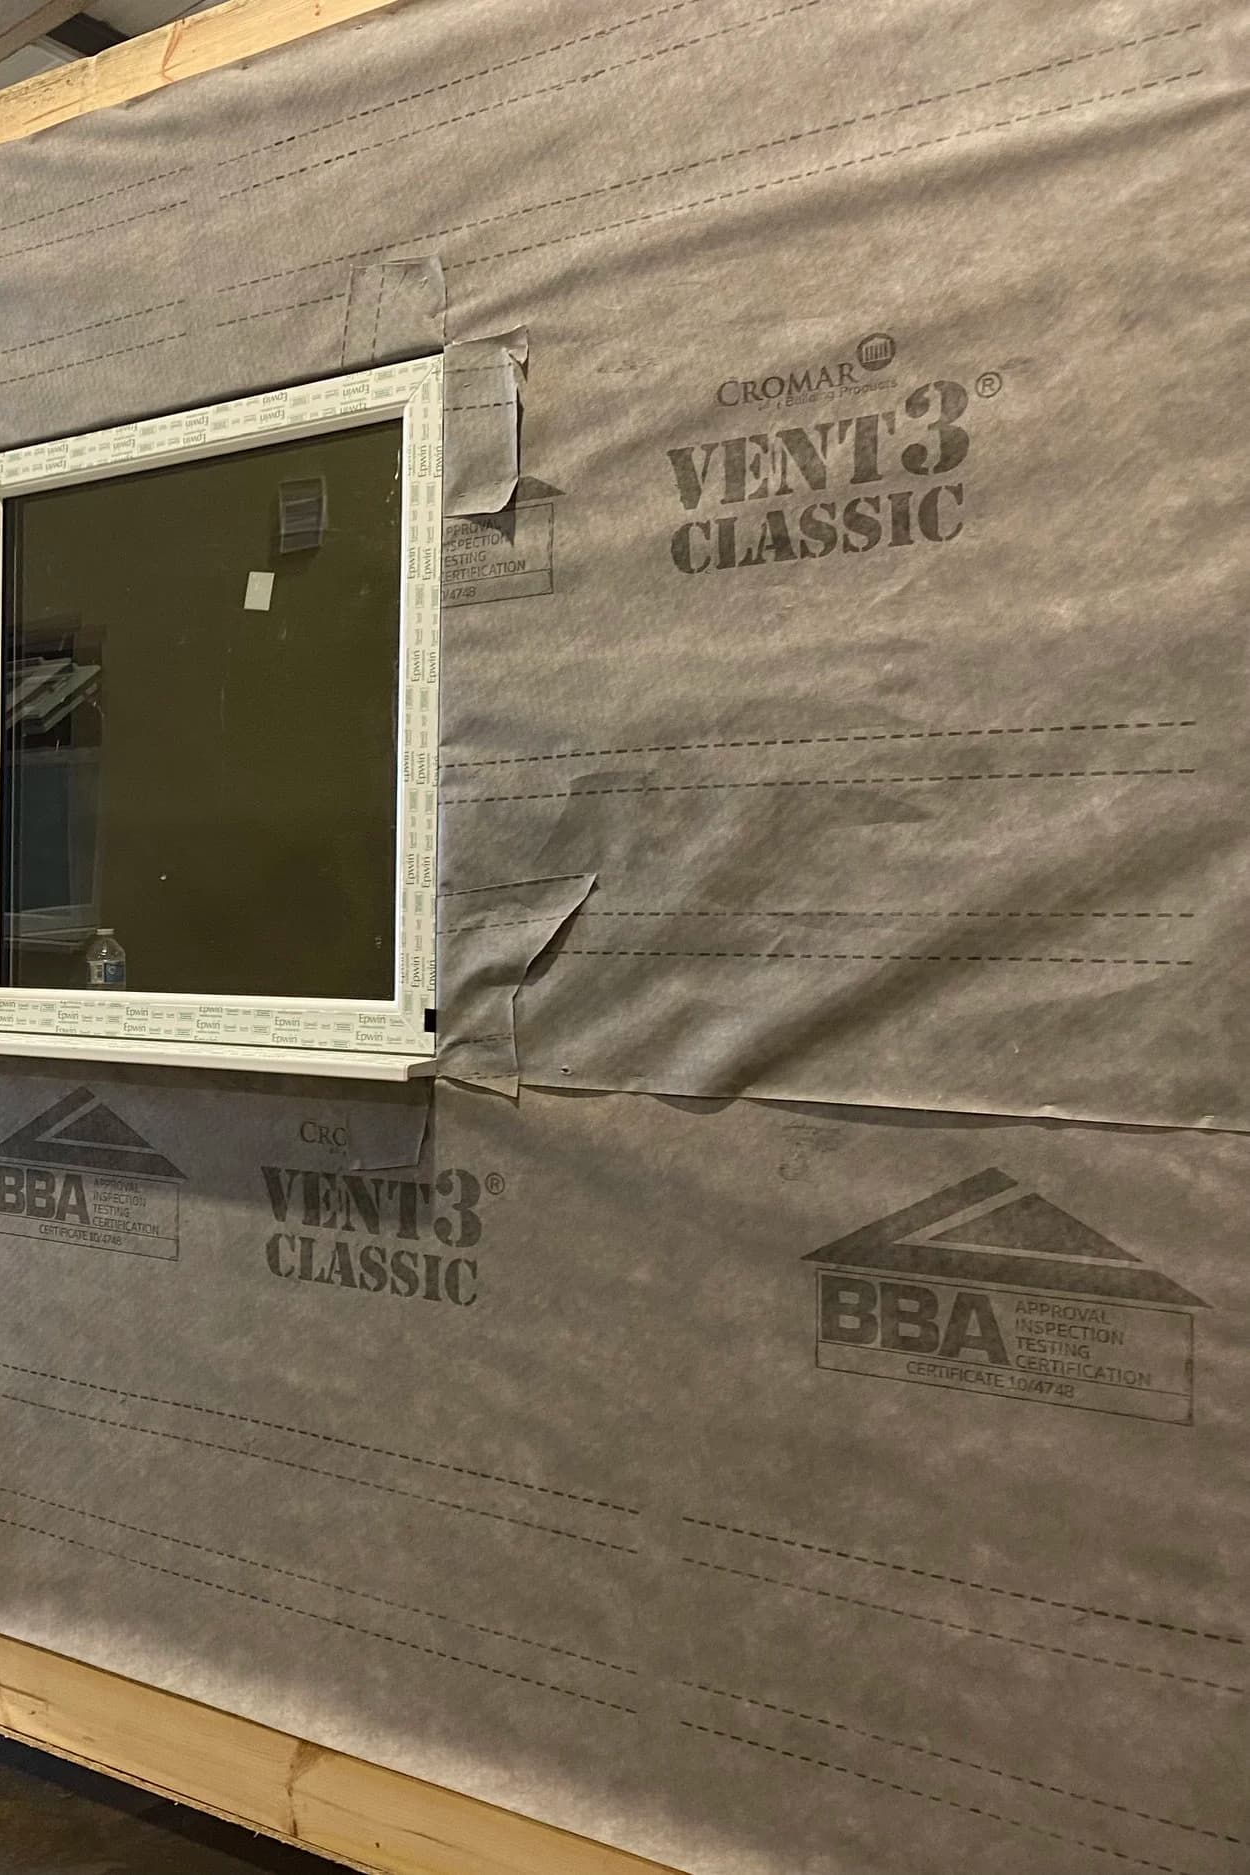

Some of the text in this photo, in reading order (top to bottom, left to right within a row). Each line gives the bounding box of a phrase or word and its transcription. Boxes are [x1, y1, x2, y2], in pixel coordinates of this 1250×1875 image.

[342, 383, 370, 397] Epwin
[716, 362, 858, 407] CROMAR
[418, 444, 427, 479] Epwin
[670, 484, 965, 574] CLASSIC
[407, 546, 416, 580] Epwin
[422, 547, 432, 581] Epwin
[411, 649, 420, 683] Epwin
[427, 650, 436, 685] Epwin
[416, 752, 425, 786] Epwin
[406, 852, 415, 886] Epwin
[421, 855, 431, 889] Epwin
[411, 955, 420, 989] Epwin
[57, 1010, 79, 1022] Epwin
[125, 1007, 149, 1018] Epwin
[196, 1019, 221, 1031] Epwin
[274, 1016, 300, 1028] Epwin
[358, 1013, 386, 1026] Epwin
[123, 1022, 147, 1034] Epwin
[271, 1032, 297, 1045] Epwin
[355, 1031, 384, 1043] Epwin
[93, 1203, 130, 1218] TESTING
[38, 1223, 88, 1241] CERTIFICATE
[265, 1233, 478, 1307] CLASSIC
[821, 1274, 1011, 1367] BBA
[1014, 1300, 1111, 1326] APPROVAL
[1014, 1318, 1125, 1346] INSPECTION
[1014, 1336, 1090, 1360] TESTING
[906, 1360, 1005, 1389] CERTIFICATE
[1014, 1354, 1151, 1387] CERTIFICATION
